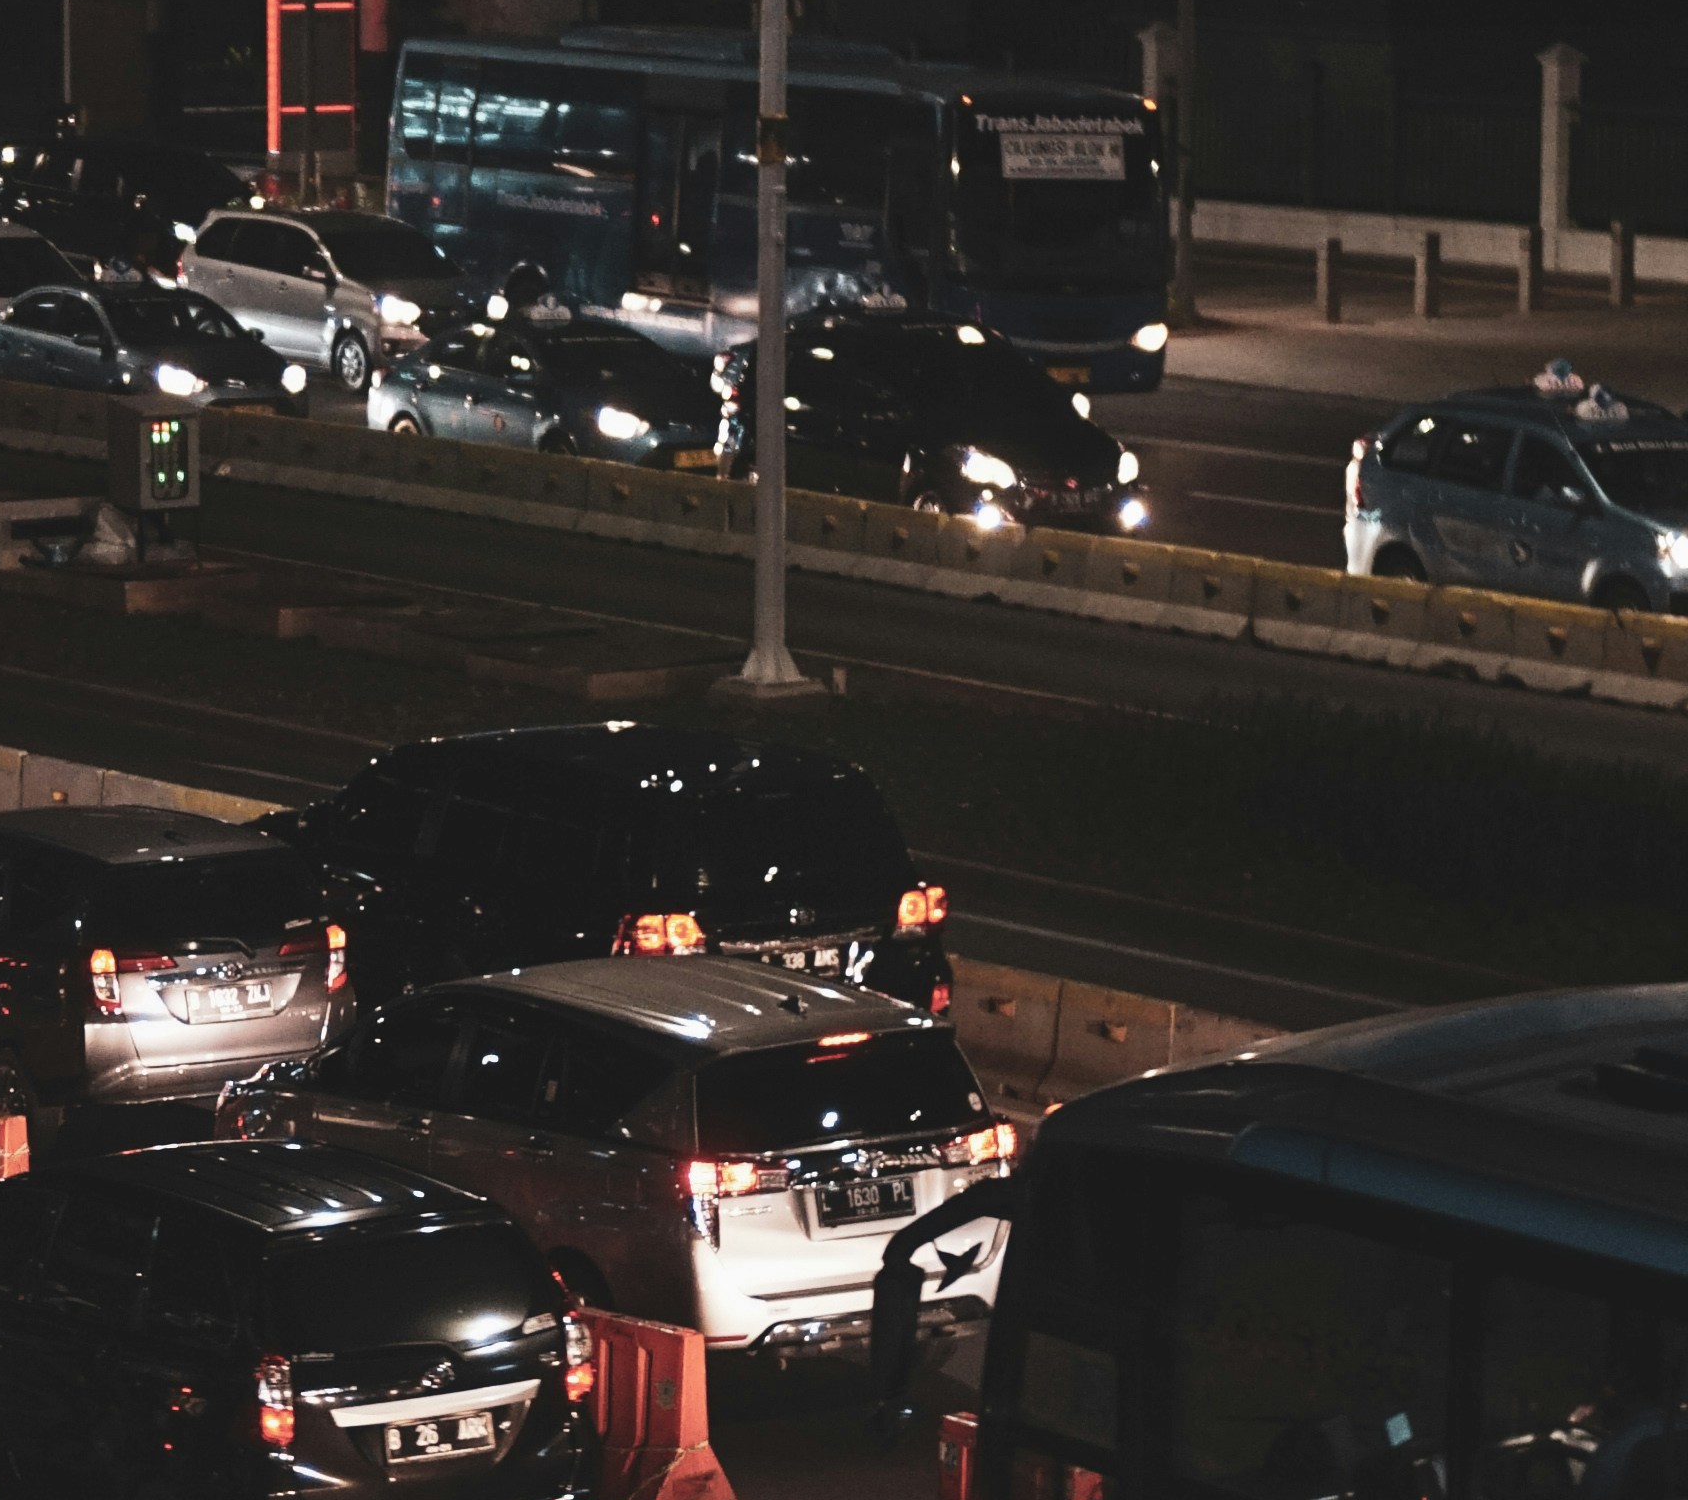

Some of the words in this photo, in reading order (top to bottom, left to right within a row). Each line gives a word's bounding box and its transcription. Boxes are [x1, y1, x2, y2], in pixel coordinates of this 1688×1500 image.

[821, 1192, 831, 1212] L
[846, 1185, 880, 1208] 1630
[892, 1181, 911, 1203] PL
